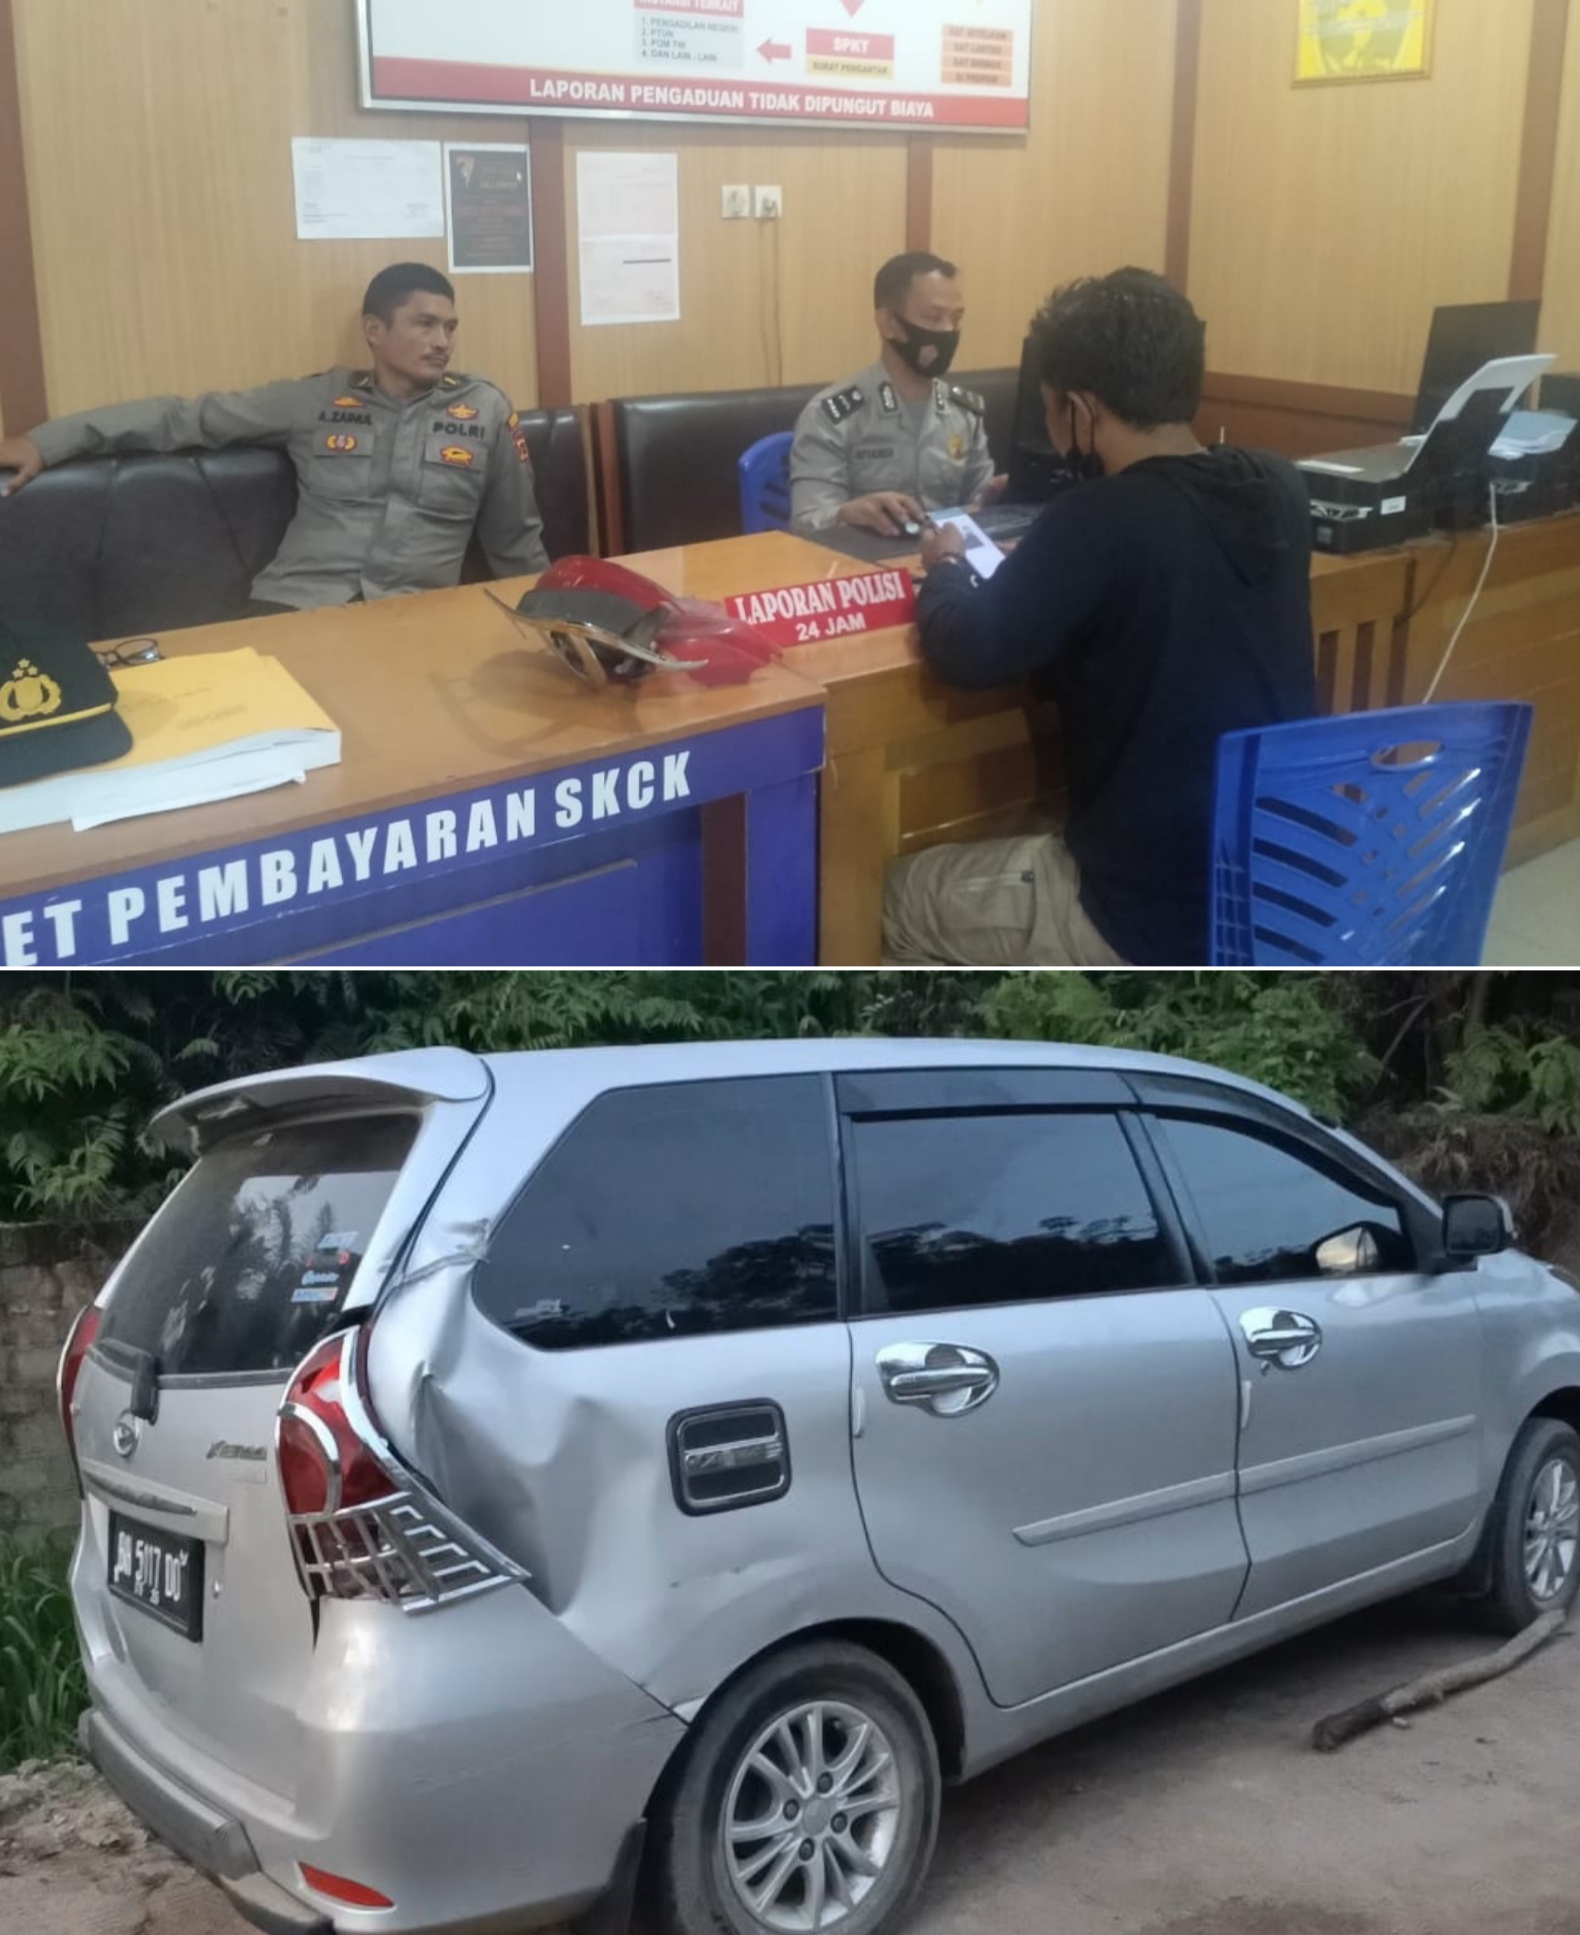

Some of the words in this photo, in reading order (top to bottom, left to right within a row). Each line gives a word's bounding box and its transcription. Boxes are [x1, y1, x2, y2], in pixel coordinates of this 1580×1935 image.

[833, 37, 869, 53] SPKT
[530, 79, 625, 103] LAPORAN
[631, 85, 744, 109] PENGADUAN
[750, 92, 800, 112] TIDAK
[805, 95, 887, 116] DIPUNGUT
[890, 100, 934, 118] BIAYA
[433, 421, 486, 439] POLRI
[735, 582, 838, 625] LAPORAN
[836, 571, 906, 609] POLISI
[796, 622, 821, 641] 24
[825, 612, 867, 636] JAM
[2, 900, 82, 966] ET
[107, 788, 536, 946] PEMBAYARAN
[555, 751, 691, 829] SKCK
